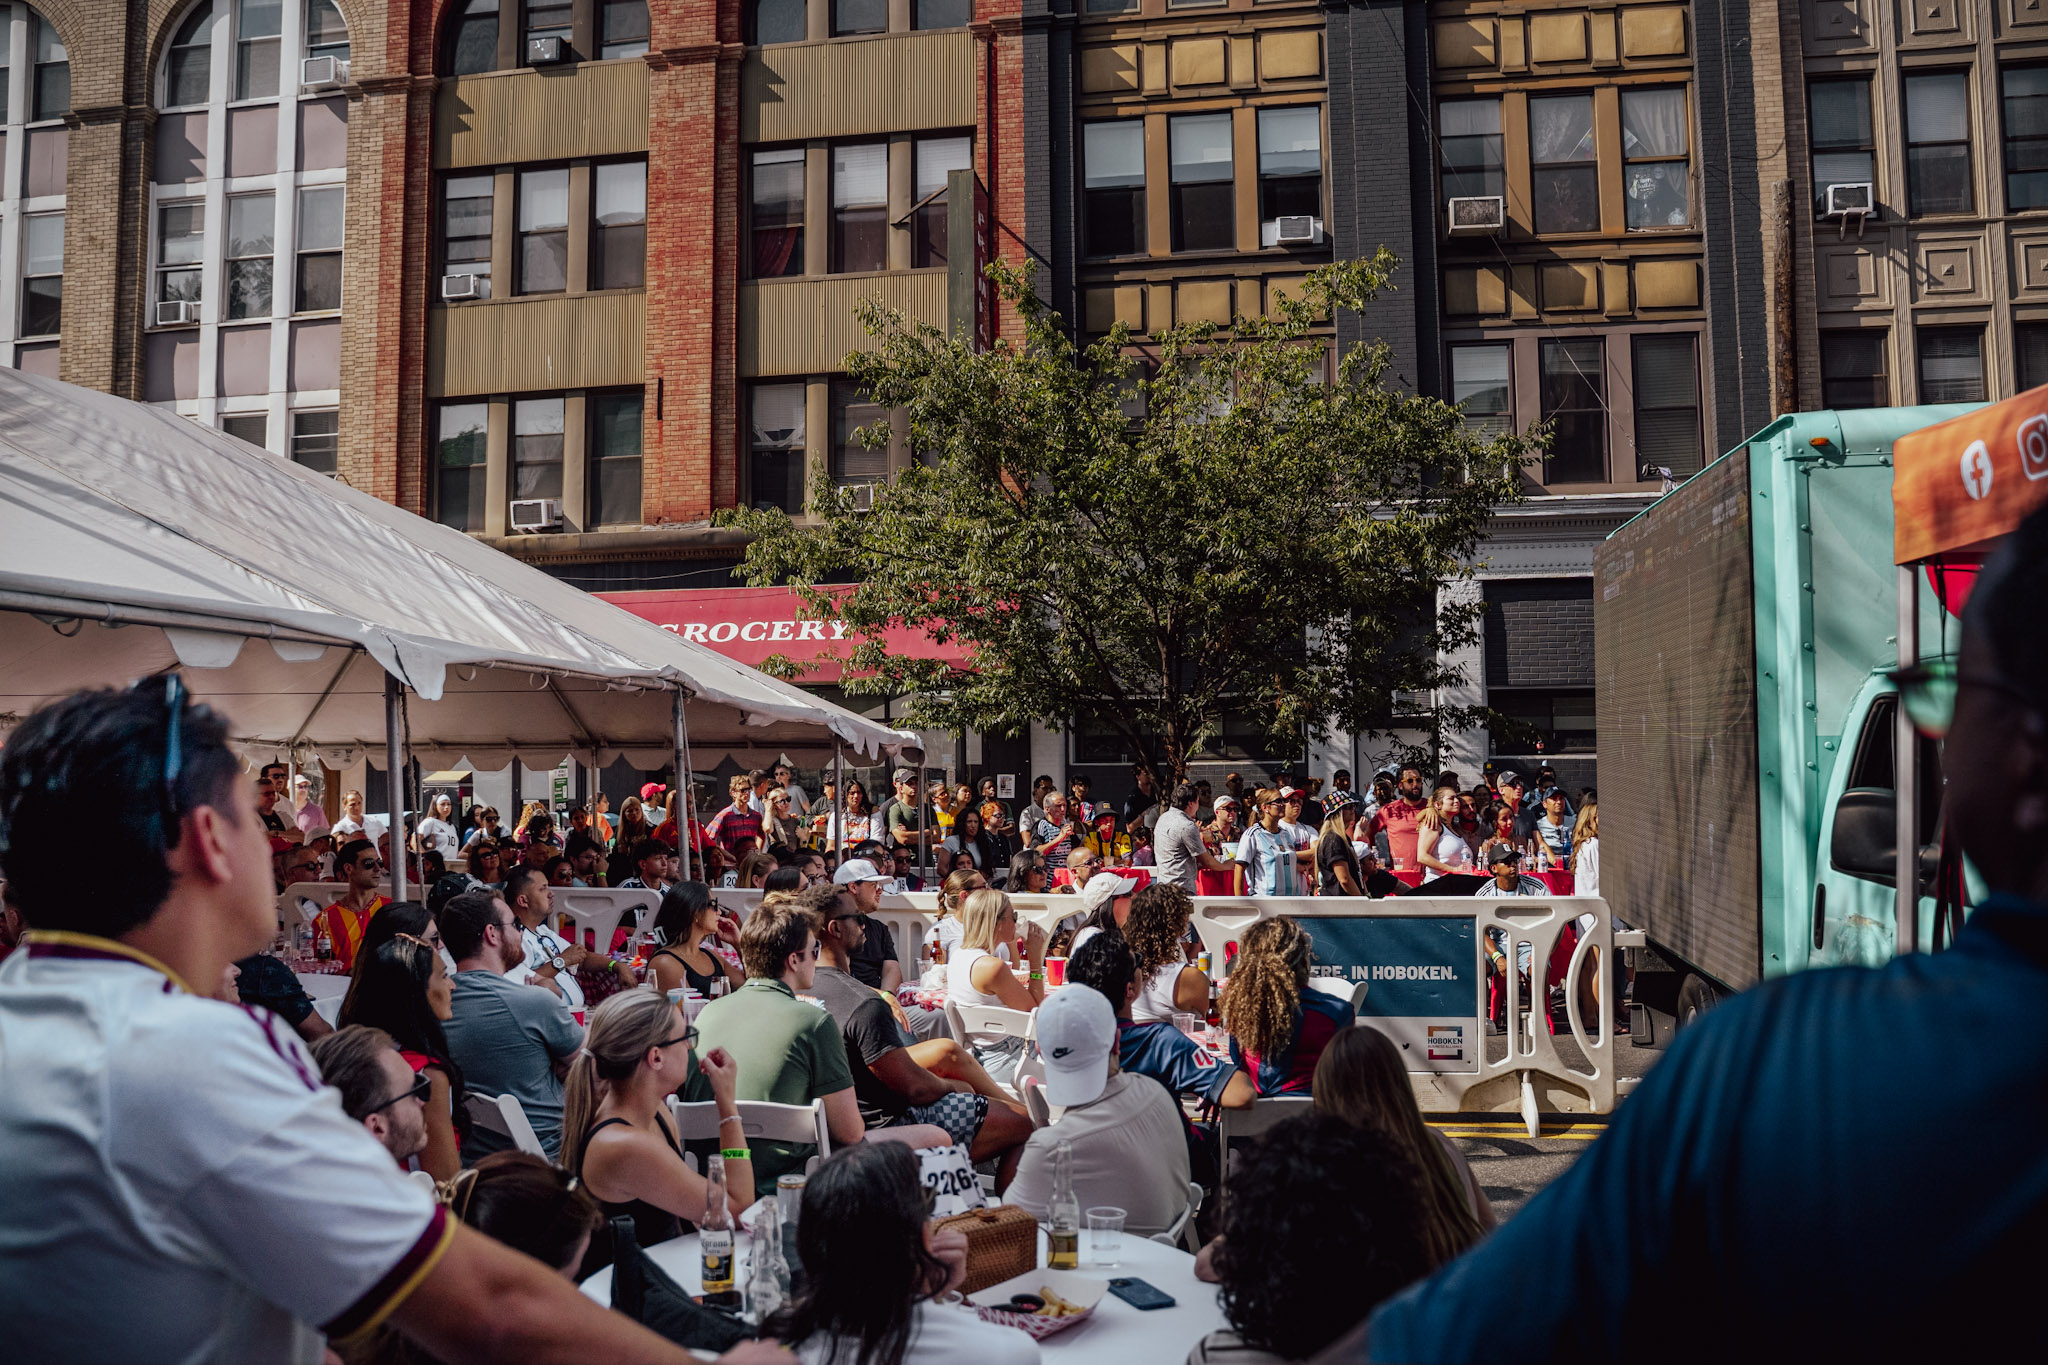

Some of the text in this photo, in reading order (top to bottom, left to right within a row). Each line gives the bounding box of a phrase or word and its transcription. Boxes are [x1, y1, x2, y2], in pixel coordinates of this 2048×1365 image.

[447, 835, 456, 847] 10
[1310, 965, 1458, 981] ERE. IN HOBOKEN.
[1427, 1037, 1463, 1045] HOBOKEN
[701, 1238, 729, 1248] Corona
